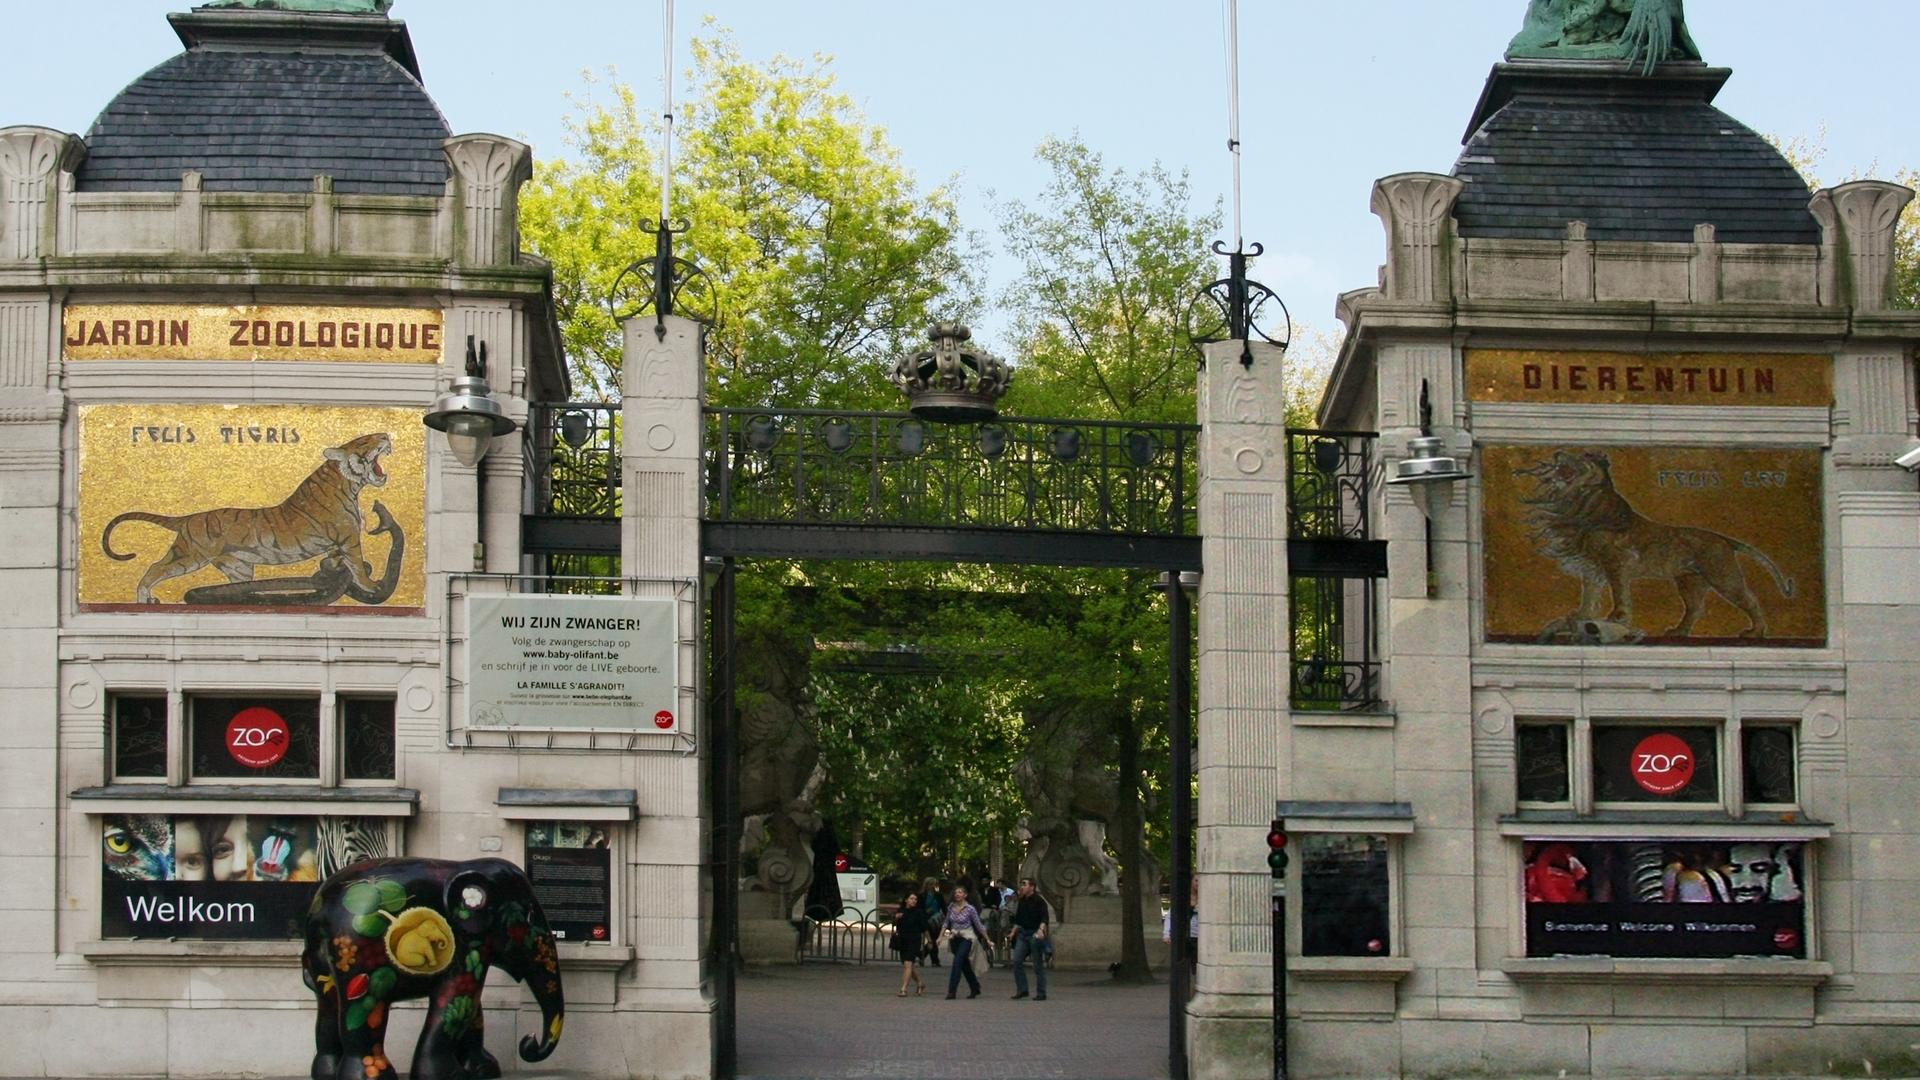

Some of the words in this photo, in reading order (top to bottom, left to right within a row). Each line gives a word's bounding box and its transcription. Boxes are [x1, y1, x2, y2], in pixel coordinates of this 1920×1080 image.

[67, 320, 189, 346] JARDIN
[229, 320, 440, 350] ZOOLOGIQUE
[1523, 364, 1774, 394] DIERENTUIN
[132, 426, 196, 443] FELIS
[220, 426, 301, 444] TIGRIS
[501, 616, 525, 629] WIJ
[530, 616, 561, 629] ZIJN
[565, 617, 641, 631] ZWANGER!
[511, 636, 532, 647] Volg
[534, 637, 546, 646] de
[549, 637, 615, 648] zwangerschap
[618, 640, 631, 649] op
[523, 649, 619, 660] www.baby-olifant.be
[481, 663, 493, 671] en
[495, 661, 526, 672] schrijf
[529, 662, 538, 672] je
[541, 662, 550, 671] in
[553, 664, 573, 672] voor
[575, 663, 588, 672] de
[591, 663, 613, 673] LIVE
[616, 664, 660, 675] geboorte.
[517, 681, 529, 689] LA
[530, 681, 567, 690] FAMILLE
[126, 895, 255, 922] Welkom
[1545, 921, 1609, 931] Bienvenue
[1619, 921, 1675, 932] Welcome
